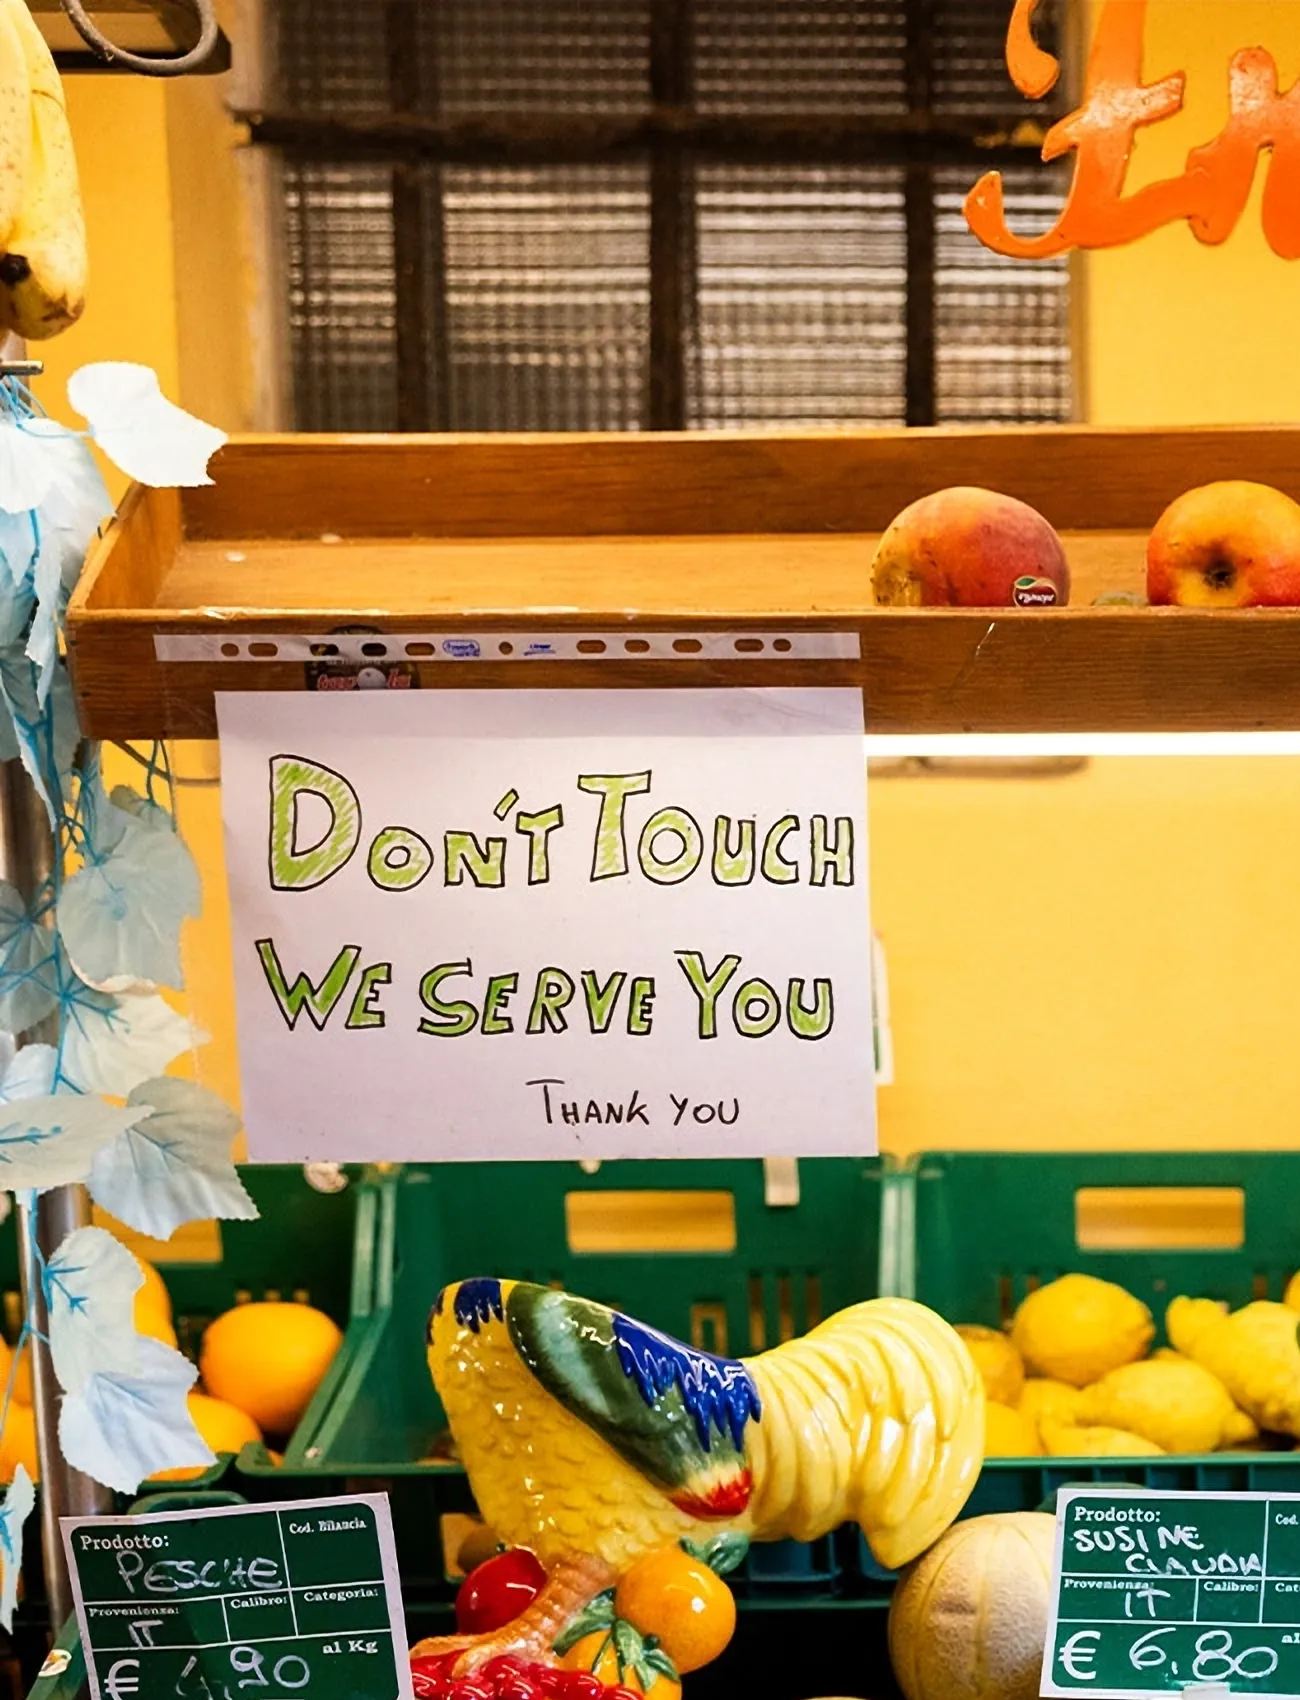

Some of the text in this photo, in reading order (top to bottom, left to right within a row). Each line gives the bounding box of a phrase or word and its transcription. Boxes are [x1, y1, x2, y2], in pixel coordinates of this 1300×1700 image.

[269, 754, 855, 892] DON'T TOUCH
[255, 937, 835, 1041] WE SERVE YOU
[525, 1078, 740, 1127] THANK YOU
[1074, 1506, 1161, 1524] Prodotto:
[1275, 1513, 1299, 1526] Cod.
[289, 1517, 367, 1535] Cod. Bilancia
[80, 1533, 170, 1551] Prodotto:
[1073, 1525, 1204, 1553] SUSINE
[116, 1550, 283, 1593] PESCHE
[1063, 1578, 1154, 1591] Provenienza:
[1204, 1582, 1259, 1593] Calibro:
[230, 1595, 287, 1610] Calibro:
[304, 1587, 379, 1603] Categoria:
[1125, 1588, 1171, 1618] IT
[89, 1606, 179, 1618] Provenienza:
[322, 1639, 378, 1655] al Kg
[1281, 1634, 1300, 1645] al
[1058, 1630, 1102, 1680] €
